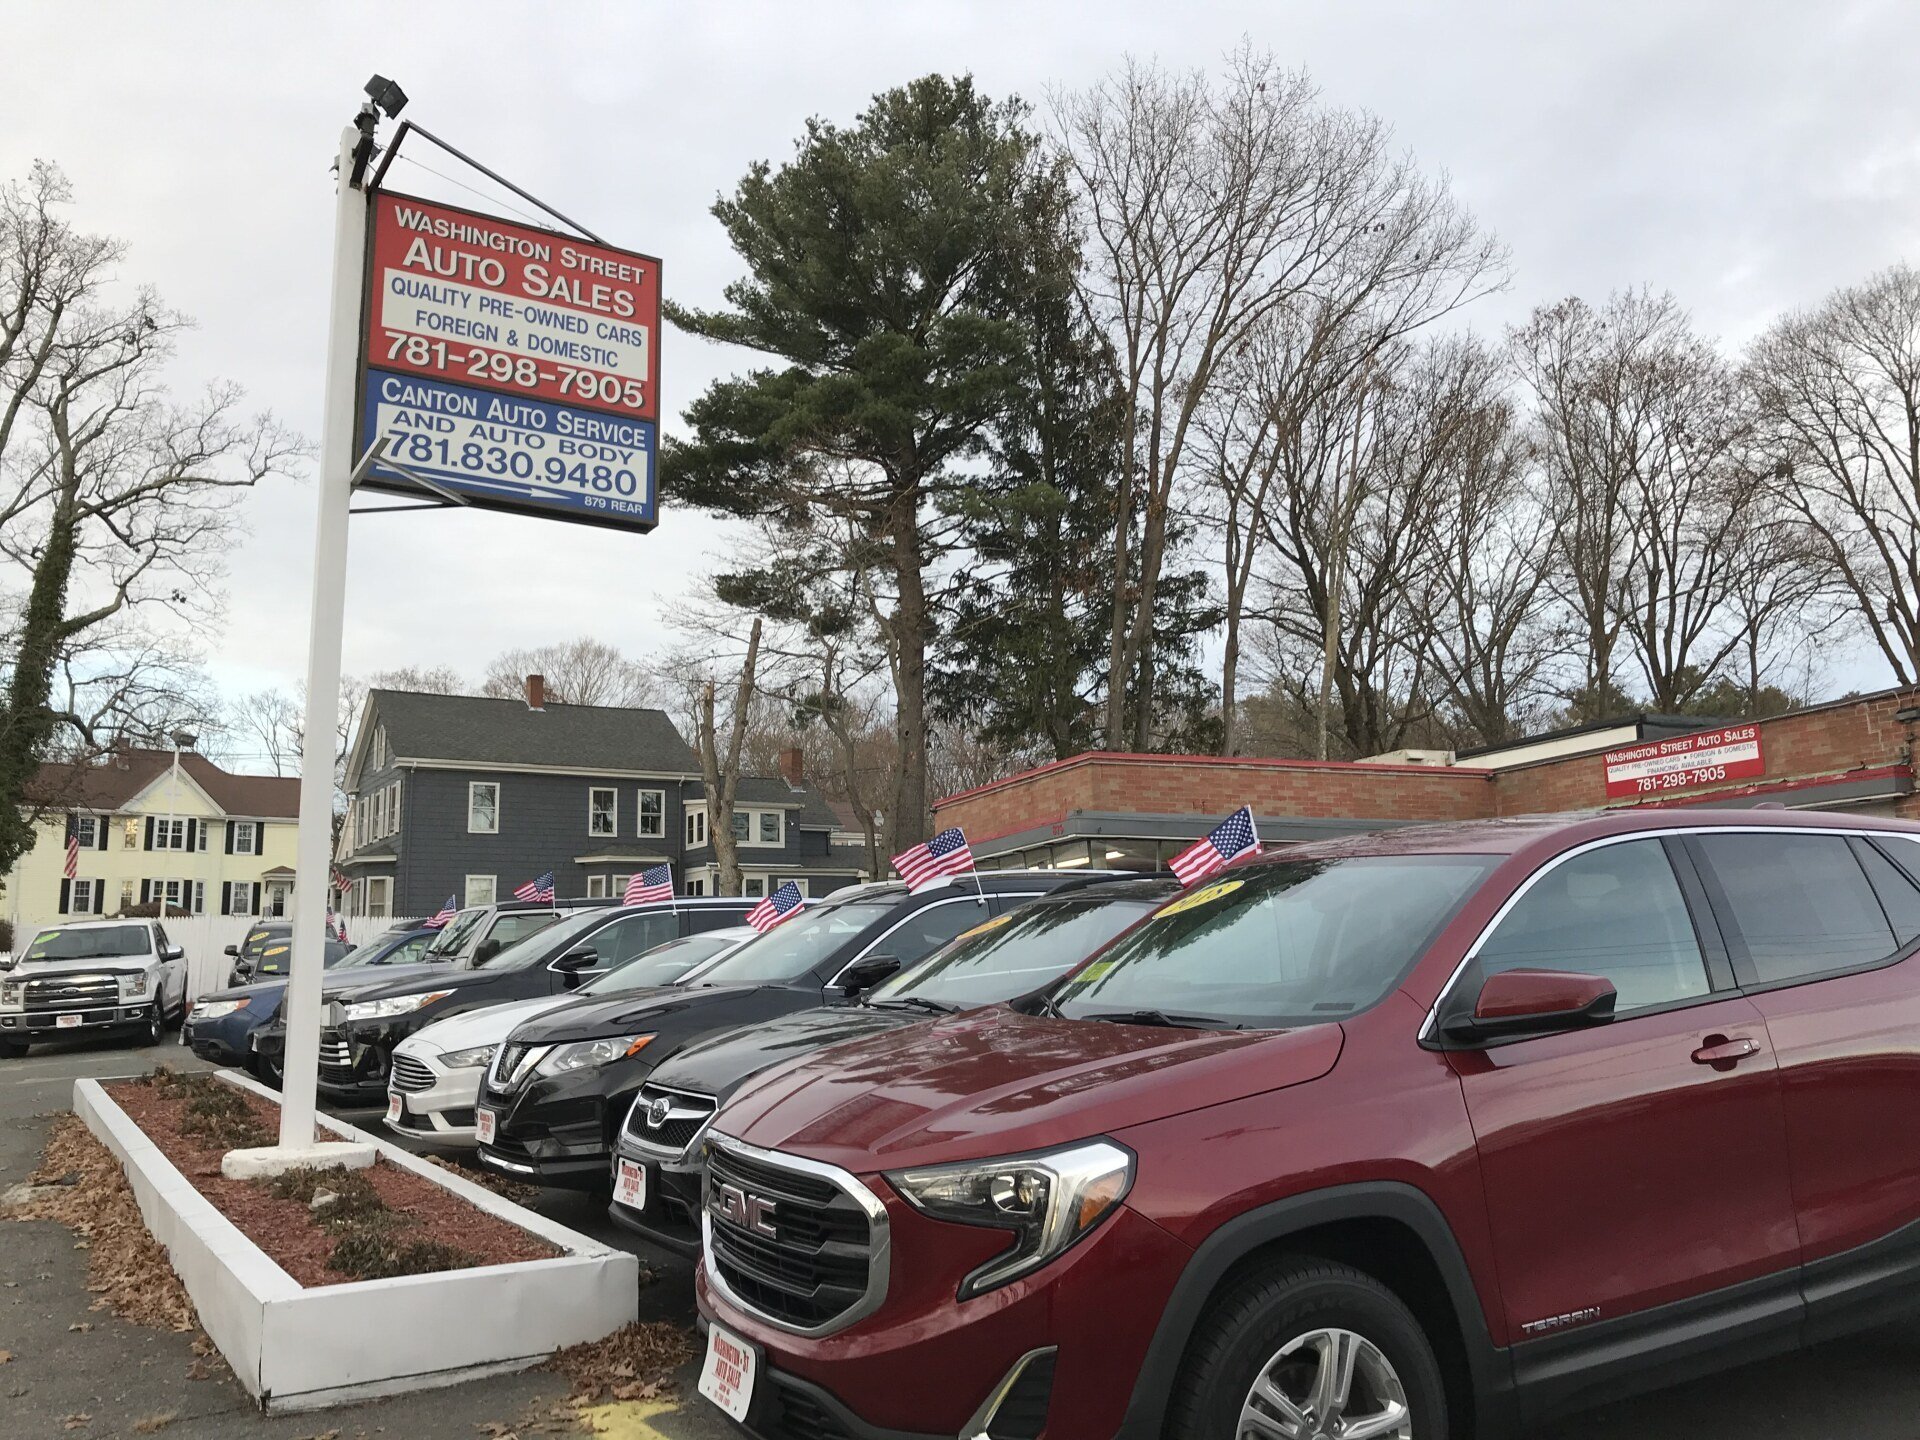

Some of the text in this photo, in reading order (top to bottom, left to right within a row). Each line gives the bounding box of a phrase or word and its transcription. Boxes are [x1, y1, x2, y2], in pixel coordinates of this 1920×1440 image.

[395, 205, 645, 284] WASHINGTON STREET
[403, 237, 634, 317] AUTO SALES
[391, 277, 642, 347] QUALITY PRE-OWNED CARS
[416, 310, 618, 368] FOREIGN & DOMESTIC
[385, 331, 645, 408] 781-298-7905
[382, 378, 646, 448] CANTON AUTO SERVICE
[392, 410, 634, 465] AND AUTO BODY
[386, 429, 637, 496] 781.830.9480
[584, 495, 642, 514] 879 REAR
[1605, 728, 1755, 764] WASHINGTON STREET AUTO SALES
[1608, 765, 1630, 774] QUALITY
[1664, 755, 1681, 764] CARS
[1689, 749, 1716, 759] FOREIGN
[1724, 742, 1756, 753] DOMESTIC
[1646, 758, 1713, 775] FINANCING AVAILABLE
[1636, 765, 1726, 792] 781-298-7905
[719, 1183, 777, 1240] GMC
[1521, 1306, 1600, 1334] TERRAIN
